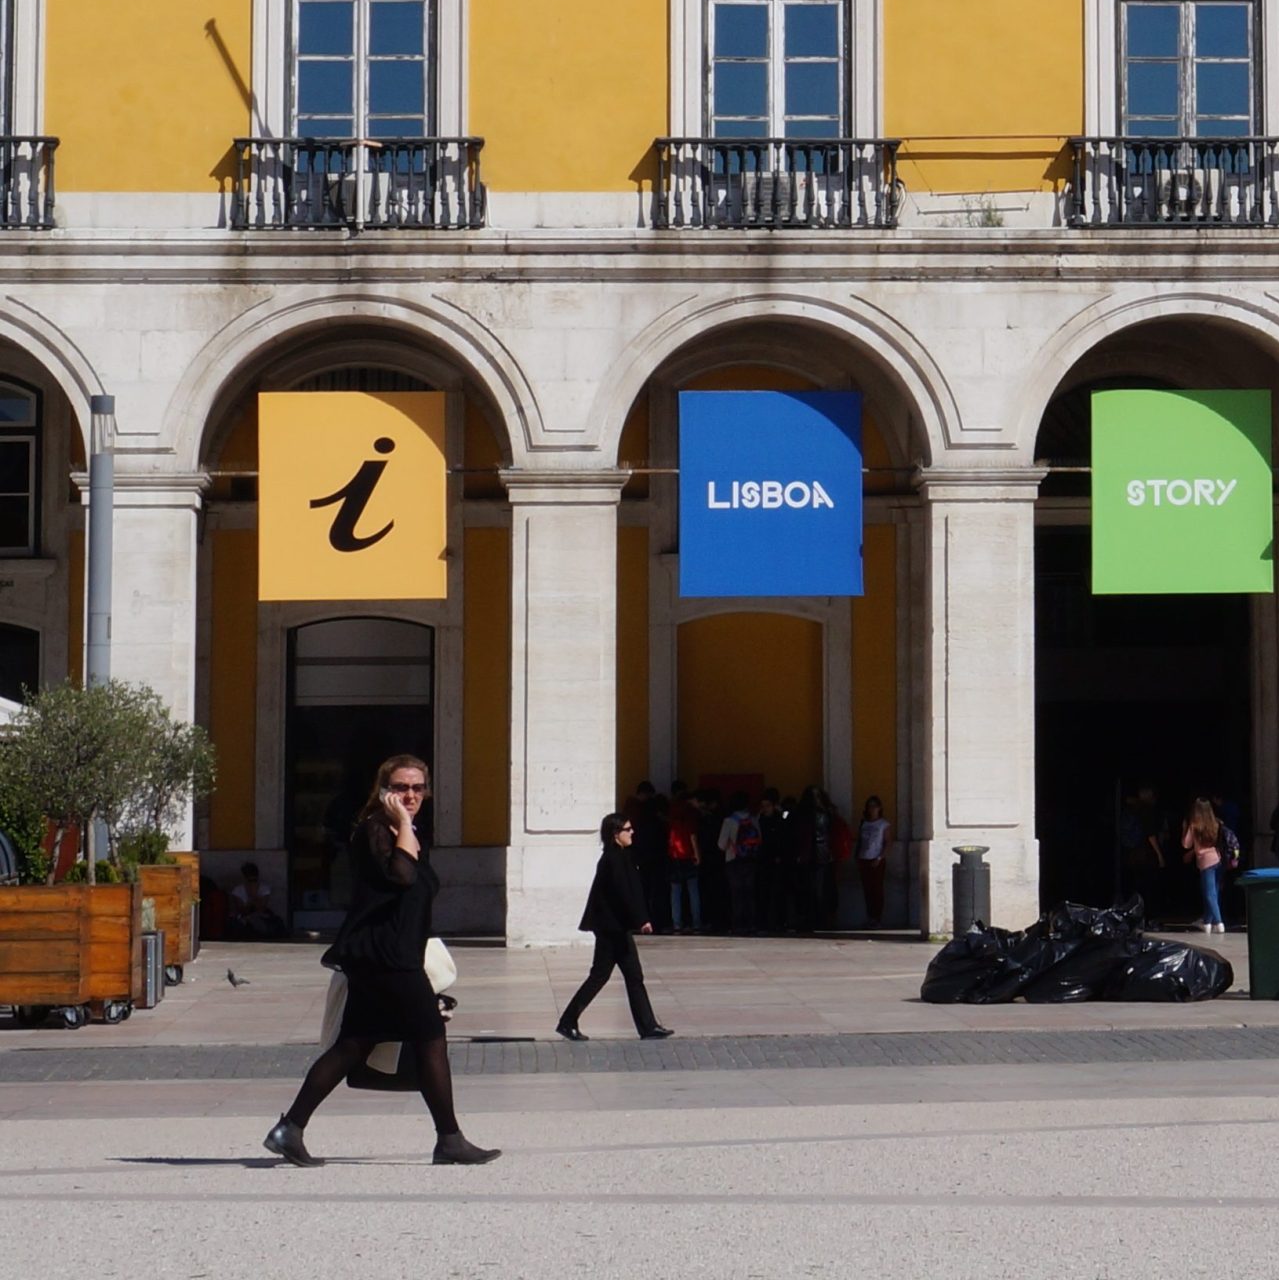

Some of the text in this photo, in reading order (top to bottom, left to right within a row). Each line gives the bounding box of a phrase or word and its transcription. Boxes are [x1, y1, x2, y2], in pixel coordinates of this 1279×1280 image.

[309, 437, 395, 552] i
[708, 480, 834, 509] LISBOA
[1126, 478, 1237, 507] STORY
